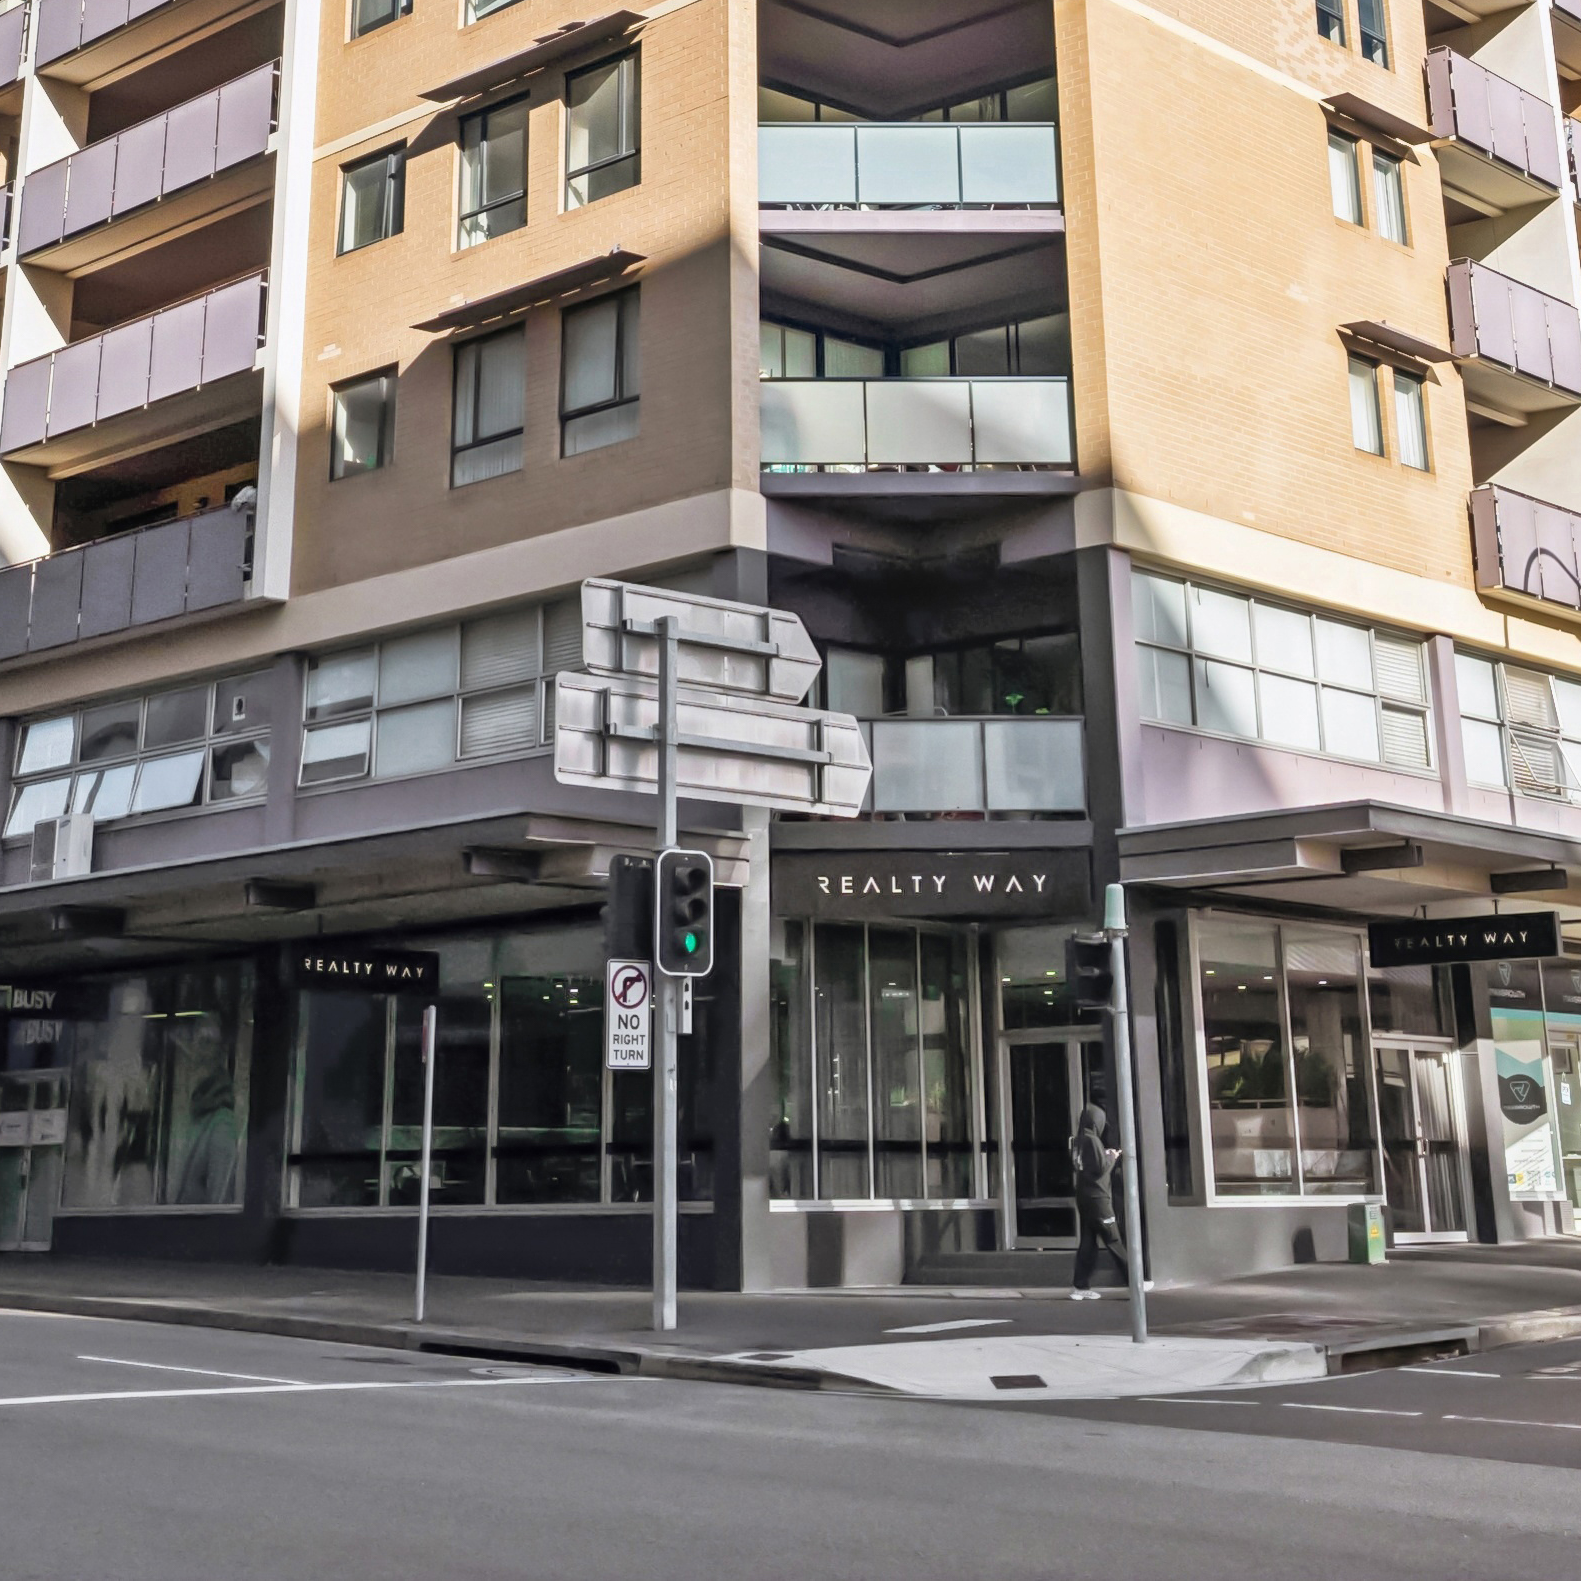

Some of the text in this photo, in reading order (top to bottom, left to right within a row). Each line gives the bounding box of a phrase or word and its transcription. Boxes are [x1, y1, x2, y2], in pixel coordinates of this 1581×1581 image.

[817, 874, 1046, 894] REALTY WAY
[1483, 930, 1528, 945] WAY
[304, 957, 424, 978] REALTY WAY
[13, 989, 57, 1010] BUSY
[617, 1014, 640, 1030] NO
[612, 1034, 646, 1046] RIGHT
[613, 1049, 644, 1061] TURN
